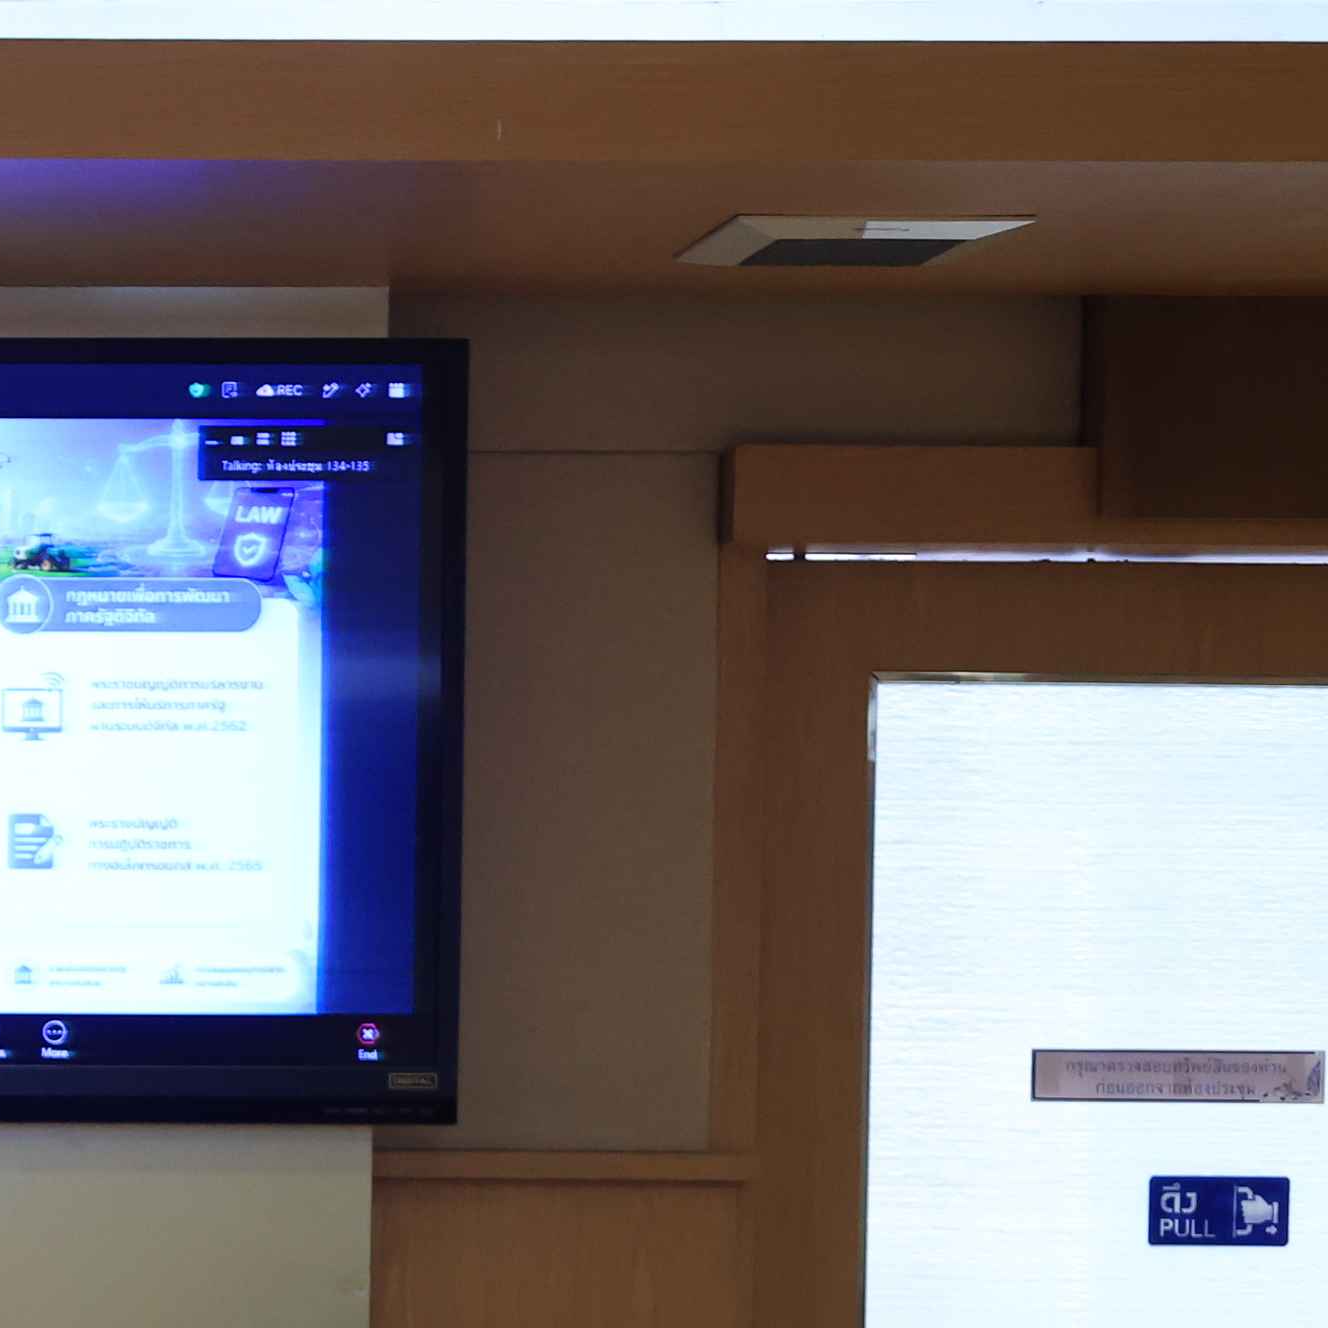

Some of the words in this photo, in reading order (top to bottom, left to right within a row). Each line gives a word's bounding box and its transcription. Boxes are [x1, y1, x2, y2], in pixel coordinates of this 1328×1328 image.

[276, 384, 303, 396] REC
[221, 459, 262, 474] Talking:
[327, 461, 370, 472] 134-135
[235, 505, 283, 524] LAW
[65, 583, 231, 606] กฎหมายเพื่อการพัฒนา
[65, 607, 157, 626] ภาครัฐดิจิทัล
[228, 859, 263, 871] 2565
[41, 1047, 69, 1058] More
[357, 1049, 378, 1061] End
[1160, 1182, 1198, 1214] ดึง
[1159, 1218, 1216, 1238] PULL
